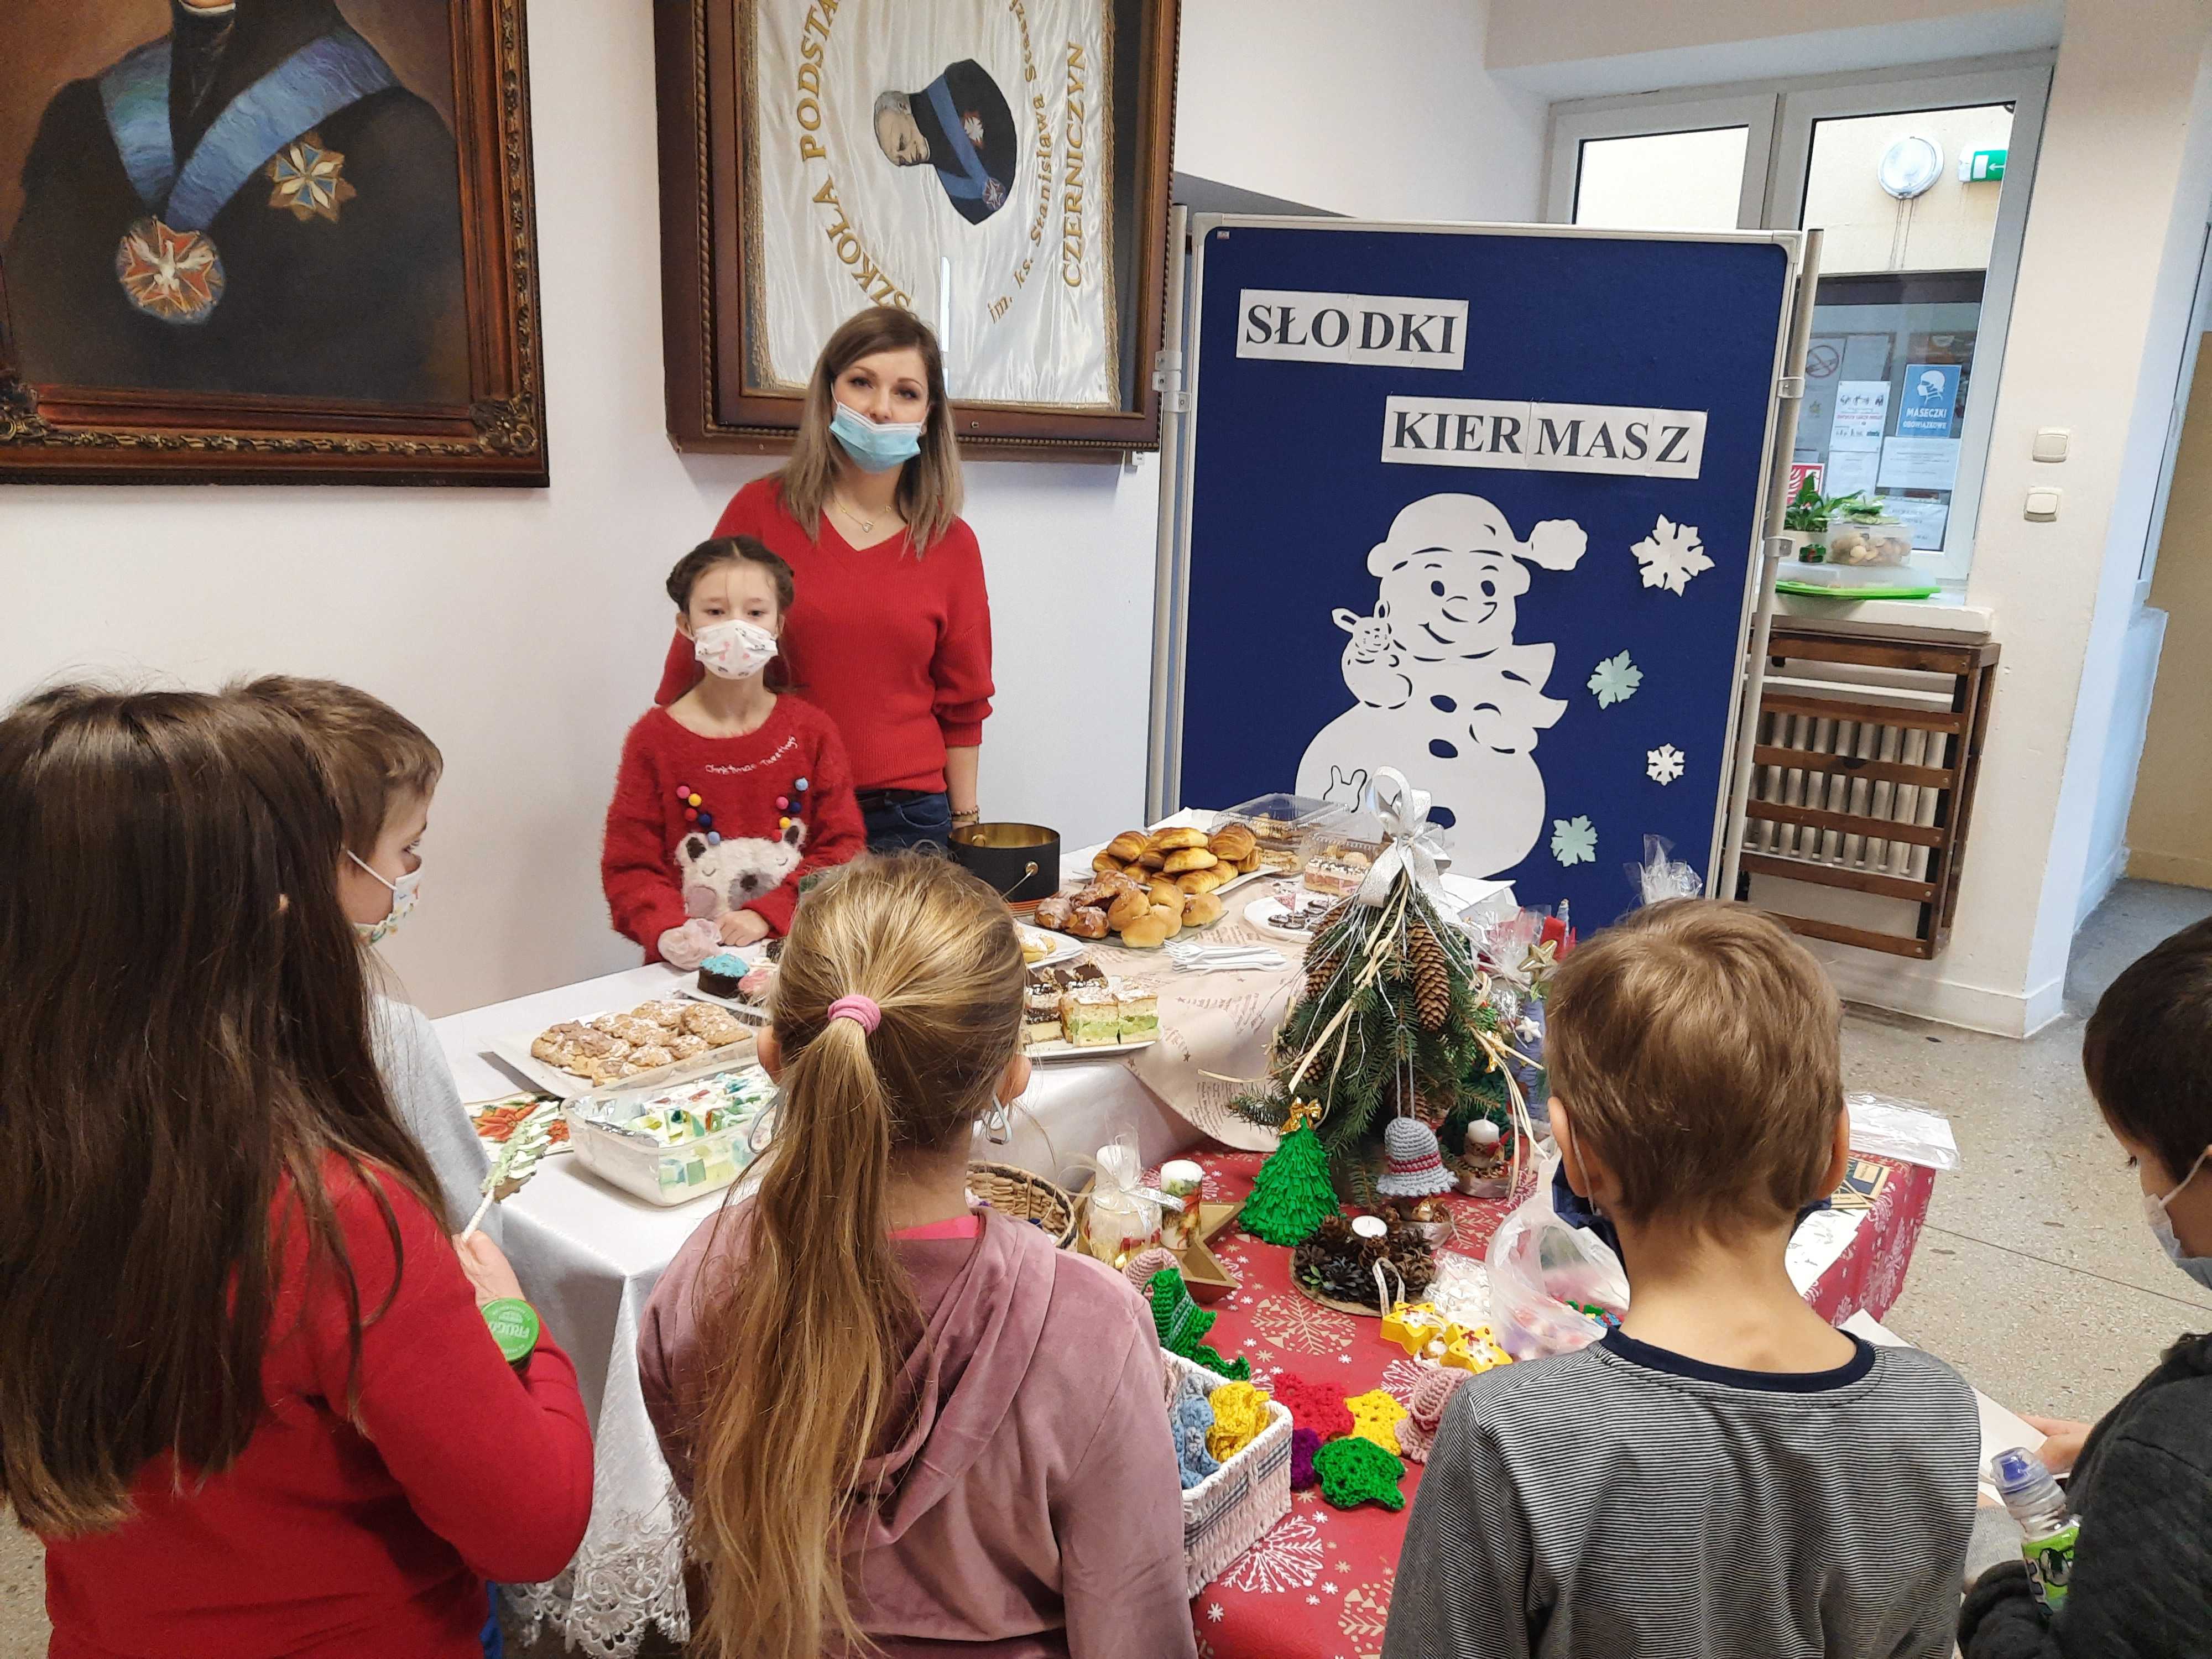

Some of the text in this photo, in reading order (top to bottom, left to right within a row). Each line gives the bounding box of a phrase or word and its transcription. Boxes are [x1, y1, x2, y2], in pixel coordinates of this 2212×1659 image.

[1063, 41, 1085, 288] CZERNICZYN
[988, 294, 1013, 325] im.
[1030, 93, 1052, 247] Stanisława
[1245, 304, 1459, 354] SŁODKI
[1392, 410, 1691, 465] KIERMASZ
[1906, 407, 1947, 419] MASECZKI
